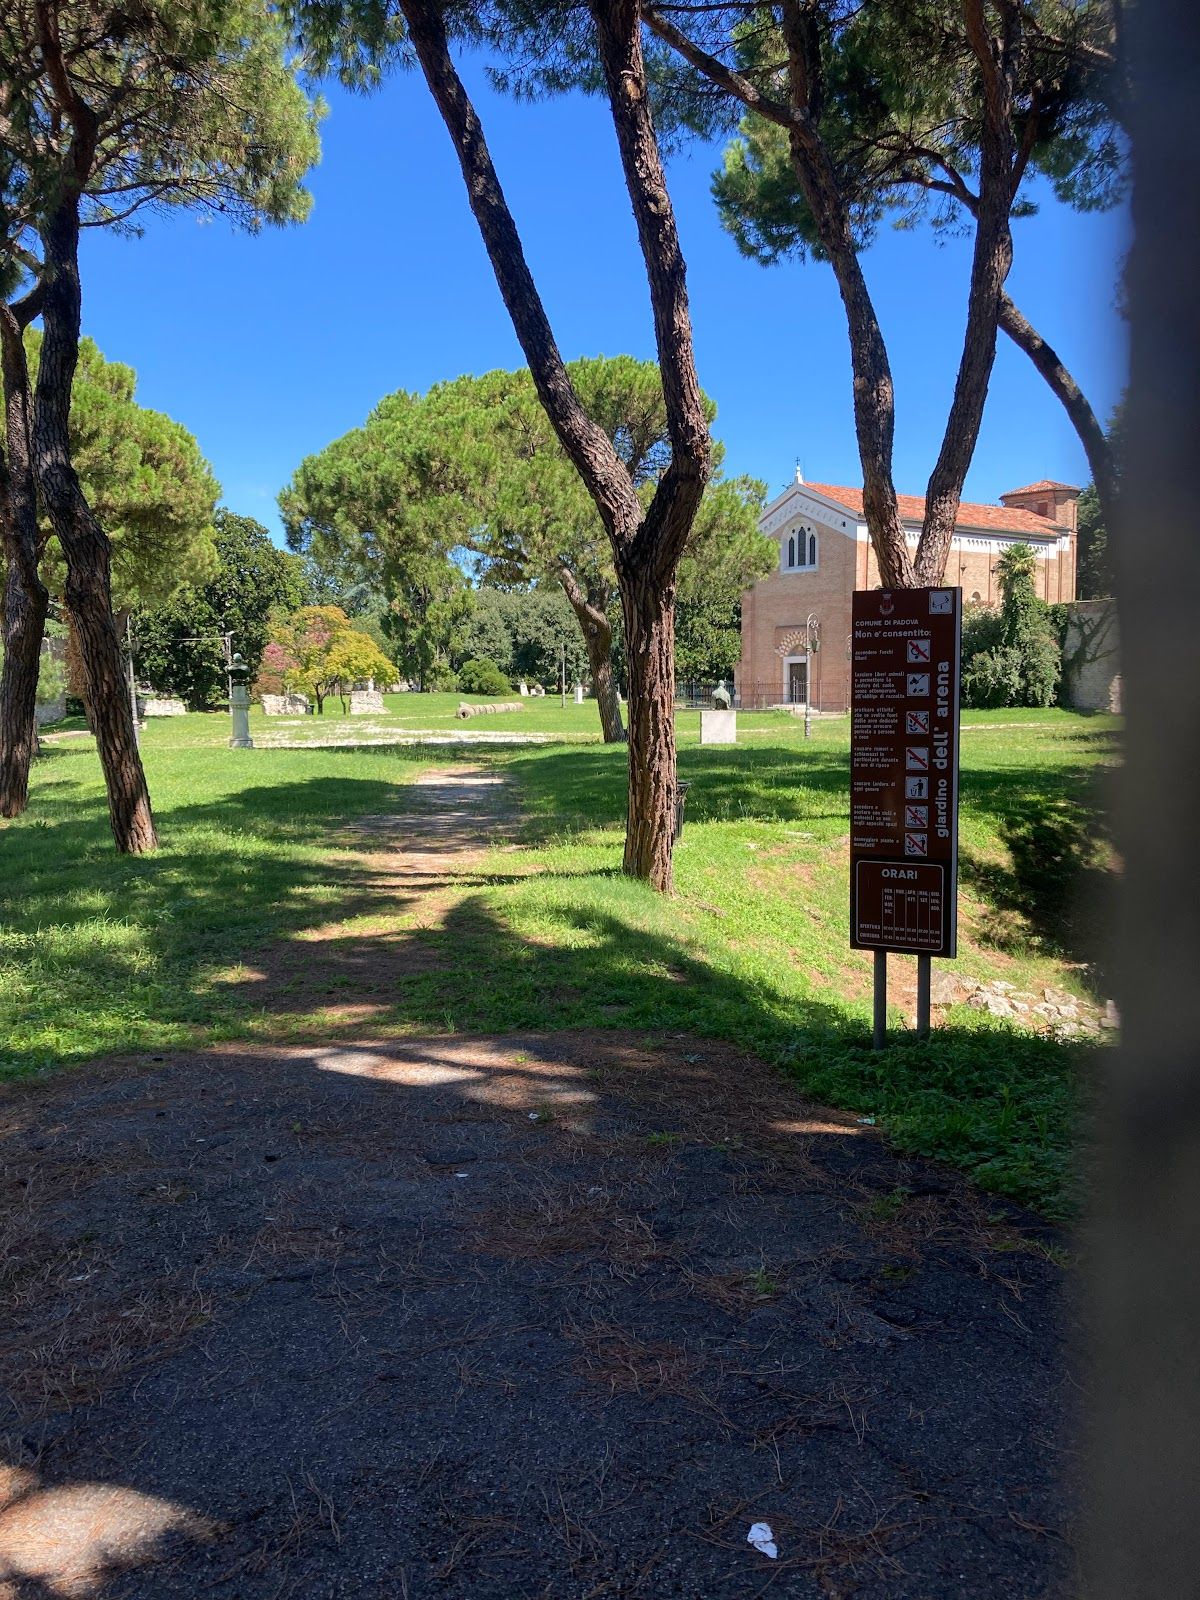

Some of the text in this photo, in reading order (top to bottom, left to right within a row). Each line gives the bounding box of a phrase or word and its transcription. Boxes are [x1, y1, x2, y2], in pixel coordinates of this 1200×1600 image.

[855, 630, 872, 638] Non
[882, 629, 931, 637] consentito:
[932, 661, 949, 838] giardino dell' arena
[882, 868, 918, 879] ORARI
